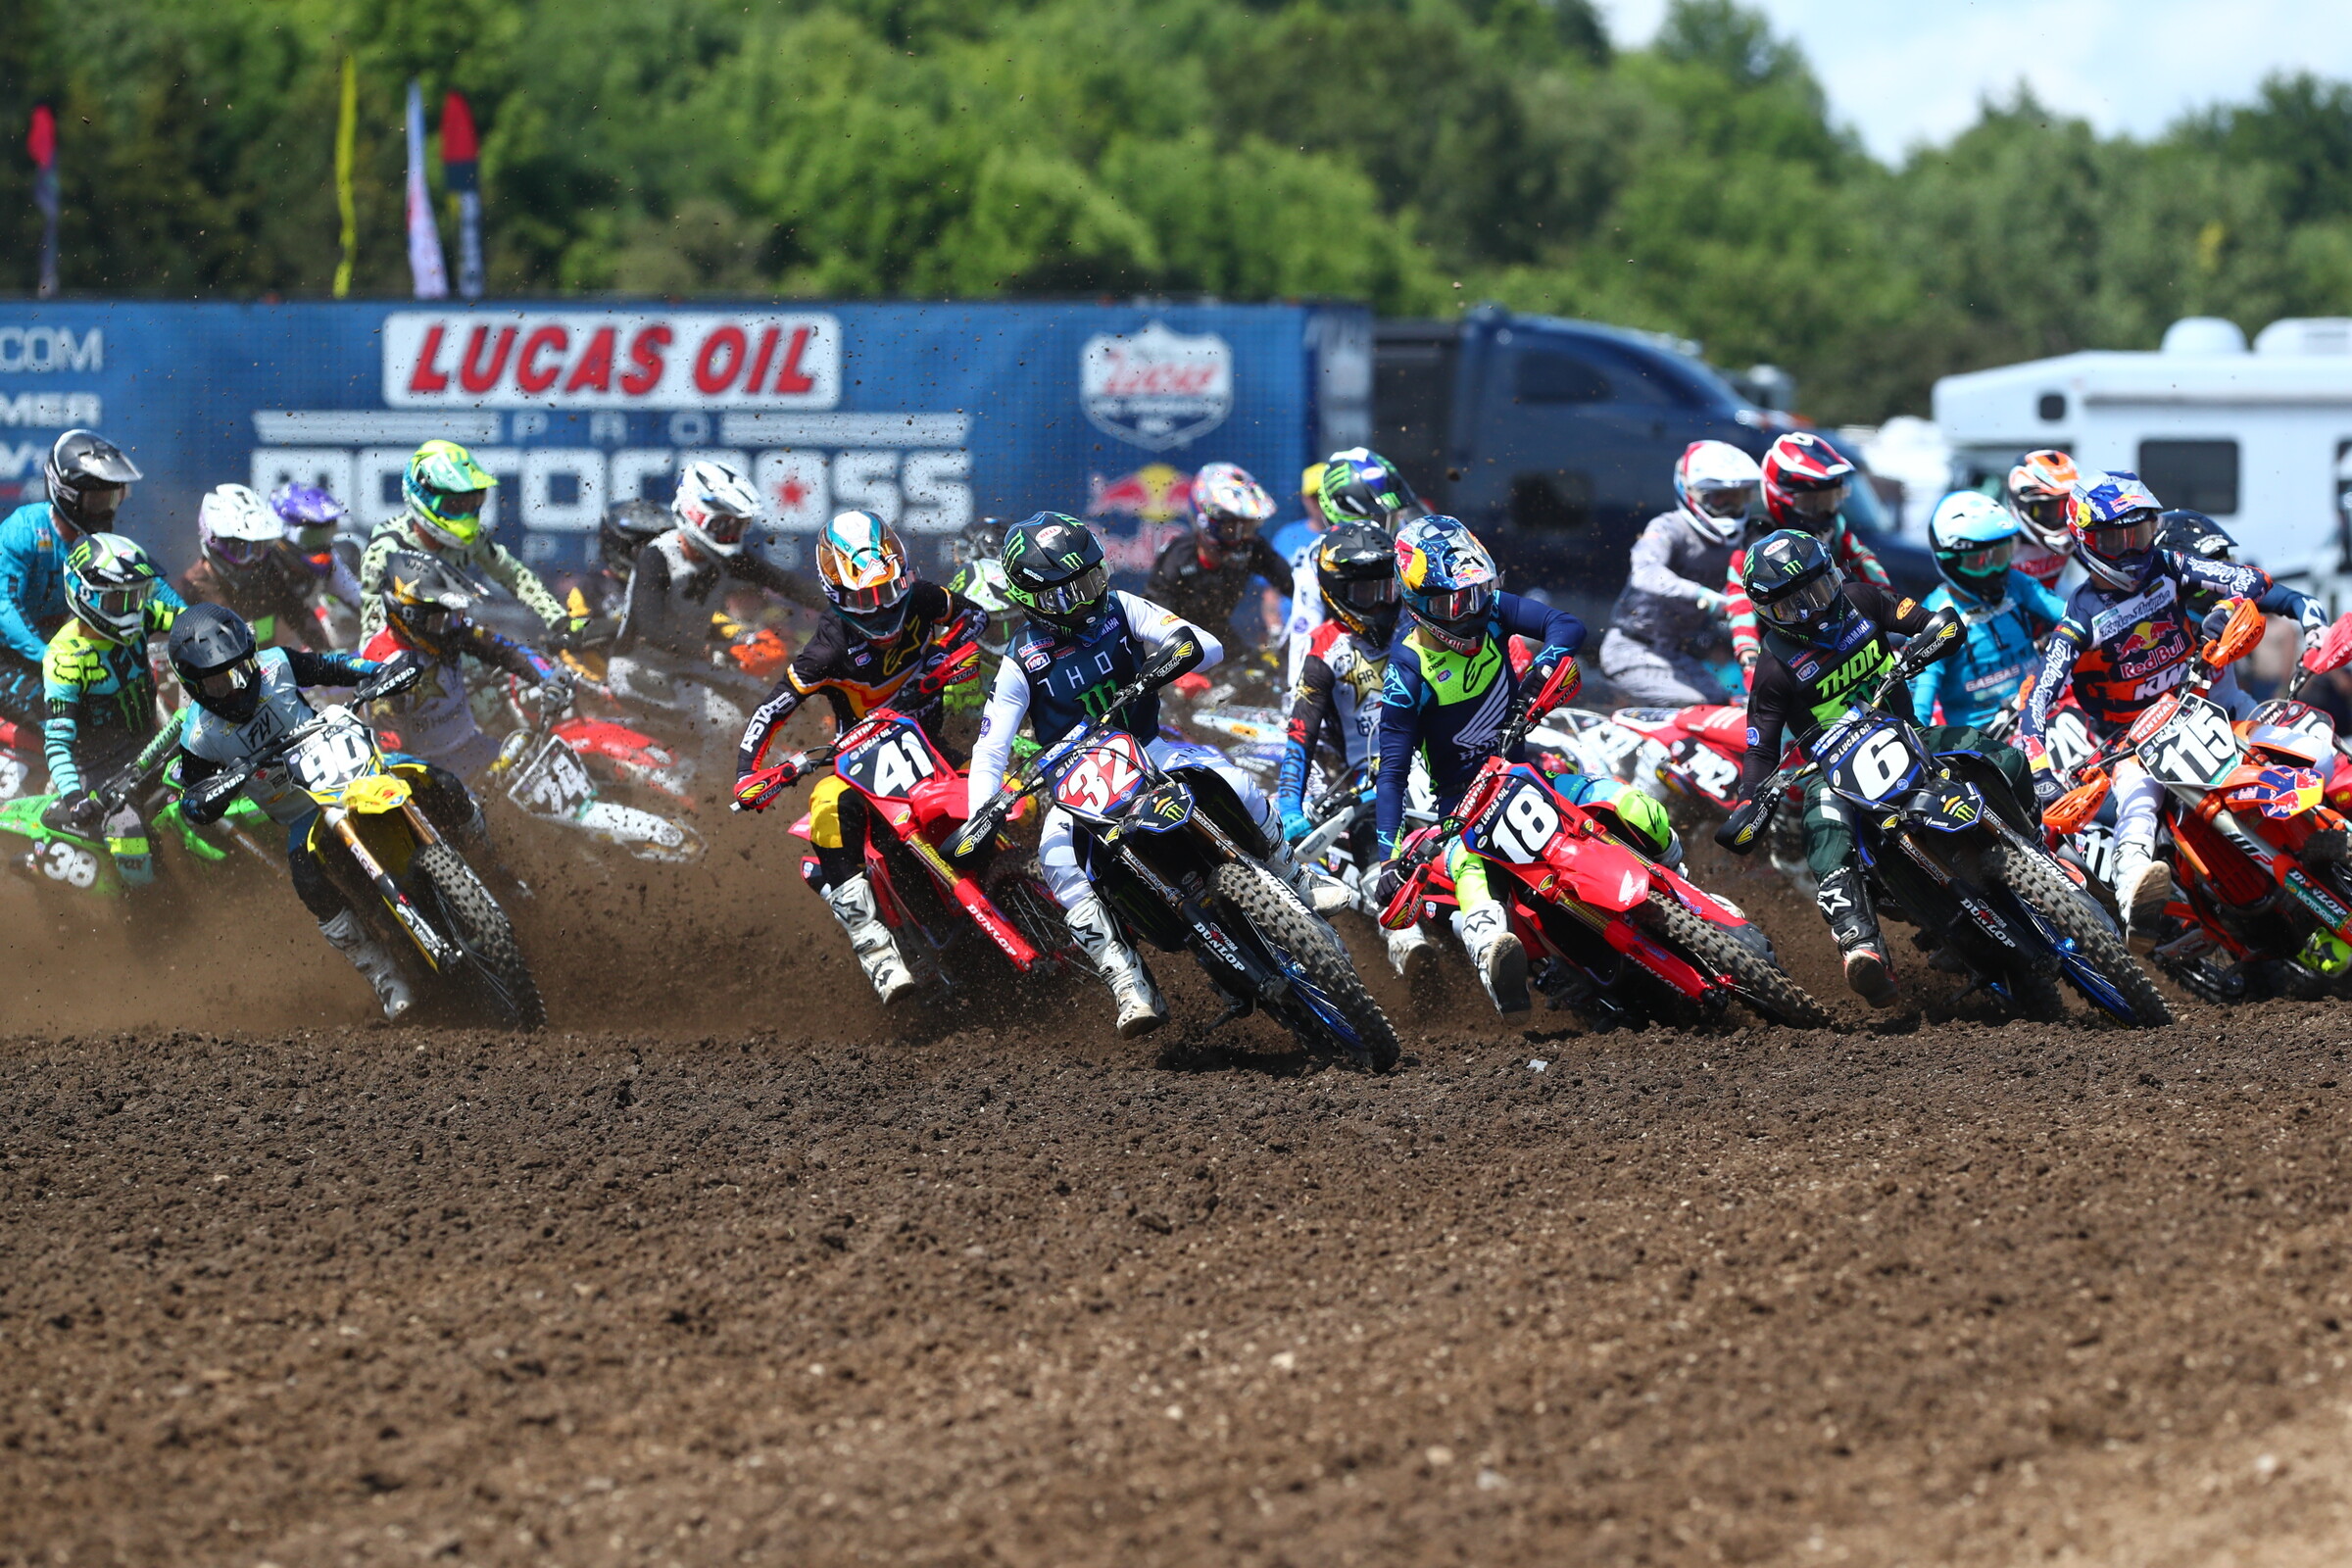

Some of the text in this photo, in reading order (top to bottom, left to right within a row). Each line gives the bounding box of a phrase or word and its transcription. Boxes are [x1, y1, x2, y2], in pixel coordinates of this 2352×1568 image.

[408, 324, 815, 394] LUCAS OIL
[251, 447, 974, 534] MOOCOSS
[1844, 619, 1871, 646] YAMAHA
[1816, 638, 1883, 699] THOR
[1965, 664, 2020, 692] GASGAS
[2121, 633, 2186, 680] Red Bull
[376, 666, 416, 696] ACERBIS
[248, 714, 272, 748] FLY
[858, 728, 893, 755] LUCAS OIL
[1838, 722, 1873, 756] LUCAS OIL
[2136, 701, 2176, 741] RENTHAL
[2159, 705, 2236, 784] 115
[299, 724, 371, 793] 90
[873, 730, 935, 799] 41
[1067, 737, 1142, 814] 32
[1852, 727, 1910, 801] 6
[205, 773, 246, 803] ACERBIS
[1481, 785, 1510, 826] LUCAS OIL
[1491, 783, 1559, 864] 18
[1545, 836, 1563, 857] HONDA
[44, 842, 97, 888] 38
[2021, 845, 2081, 893] DUNLOP
[966, 903, 1018, 956] DUNLOP
[1960, 898, 2017, 949] DUNLOP
[2296, 891, 2338, 928] MOTOREX
[1193, 921, 1246, 972] DUNLOP
